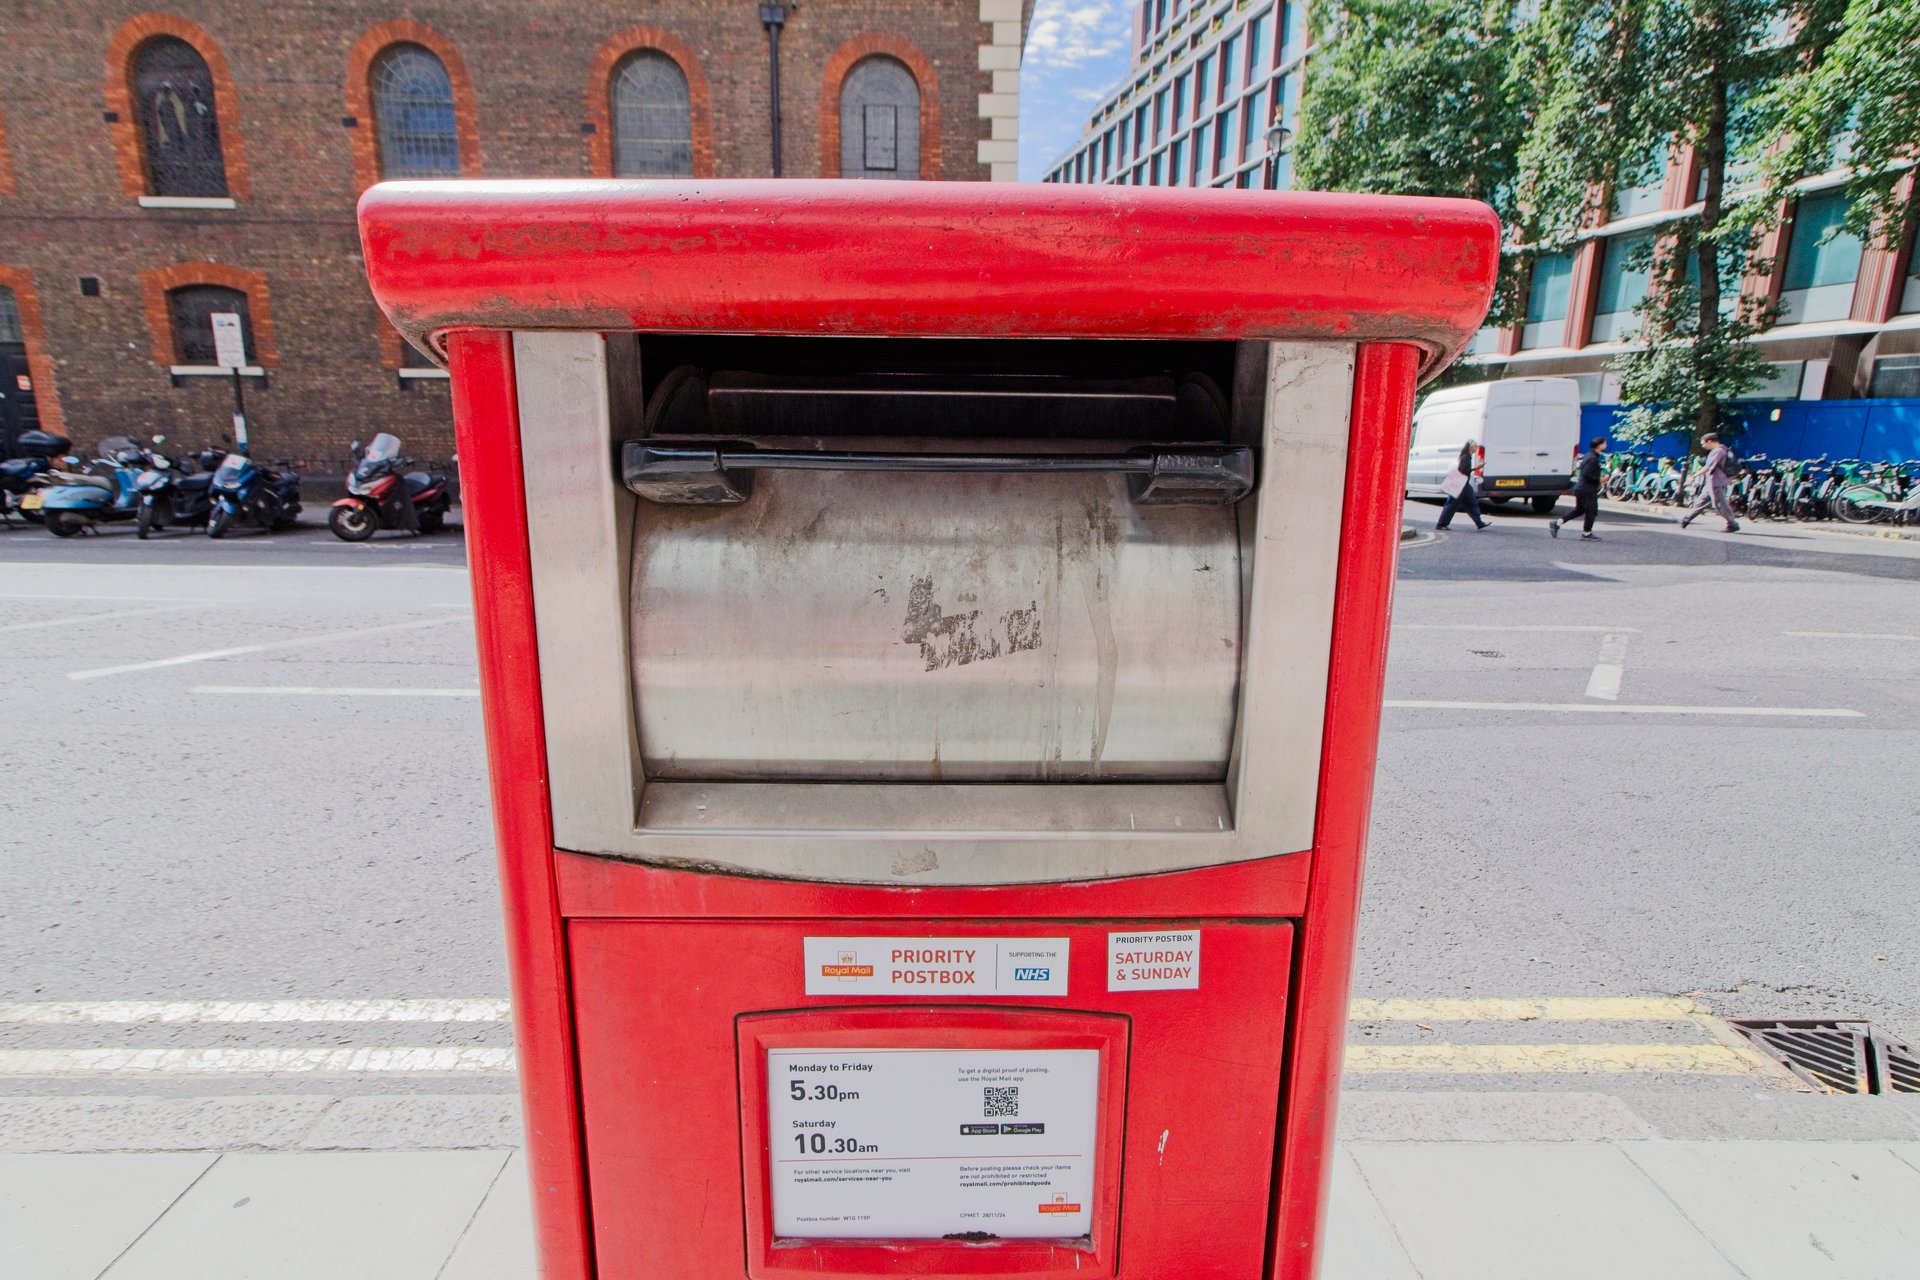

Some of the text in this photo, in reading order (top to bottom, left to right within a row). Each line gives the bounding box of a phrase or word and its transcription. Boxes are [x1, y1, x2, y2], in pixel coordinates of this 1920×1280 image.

[892, 950, 976, 963] PRIORITY
[1116, 951, 1192, 964] SATURDAY
[825, 967, 850, 976] Royal
[892, 970, 975, 984] POSTBOX
[1016, 970, 1048, 980] NHS
[1116, 967, 1192, 980] & SUNDAY
[789, 1064, 827, 1072] Monday
[792, 1120, 836, 1128] Saturday
